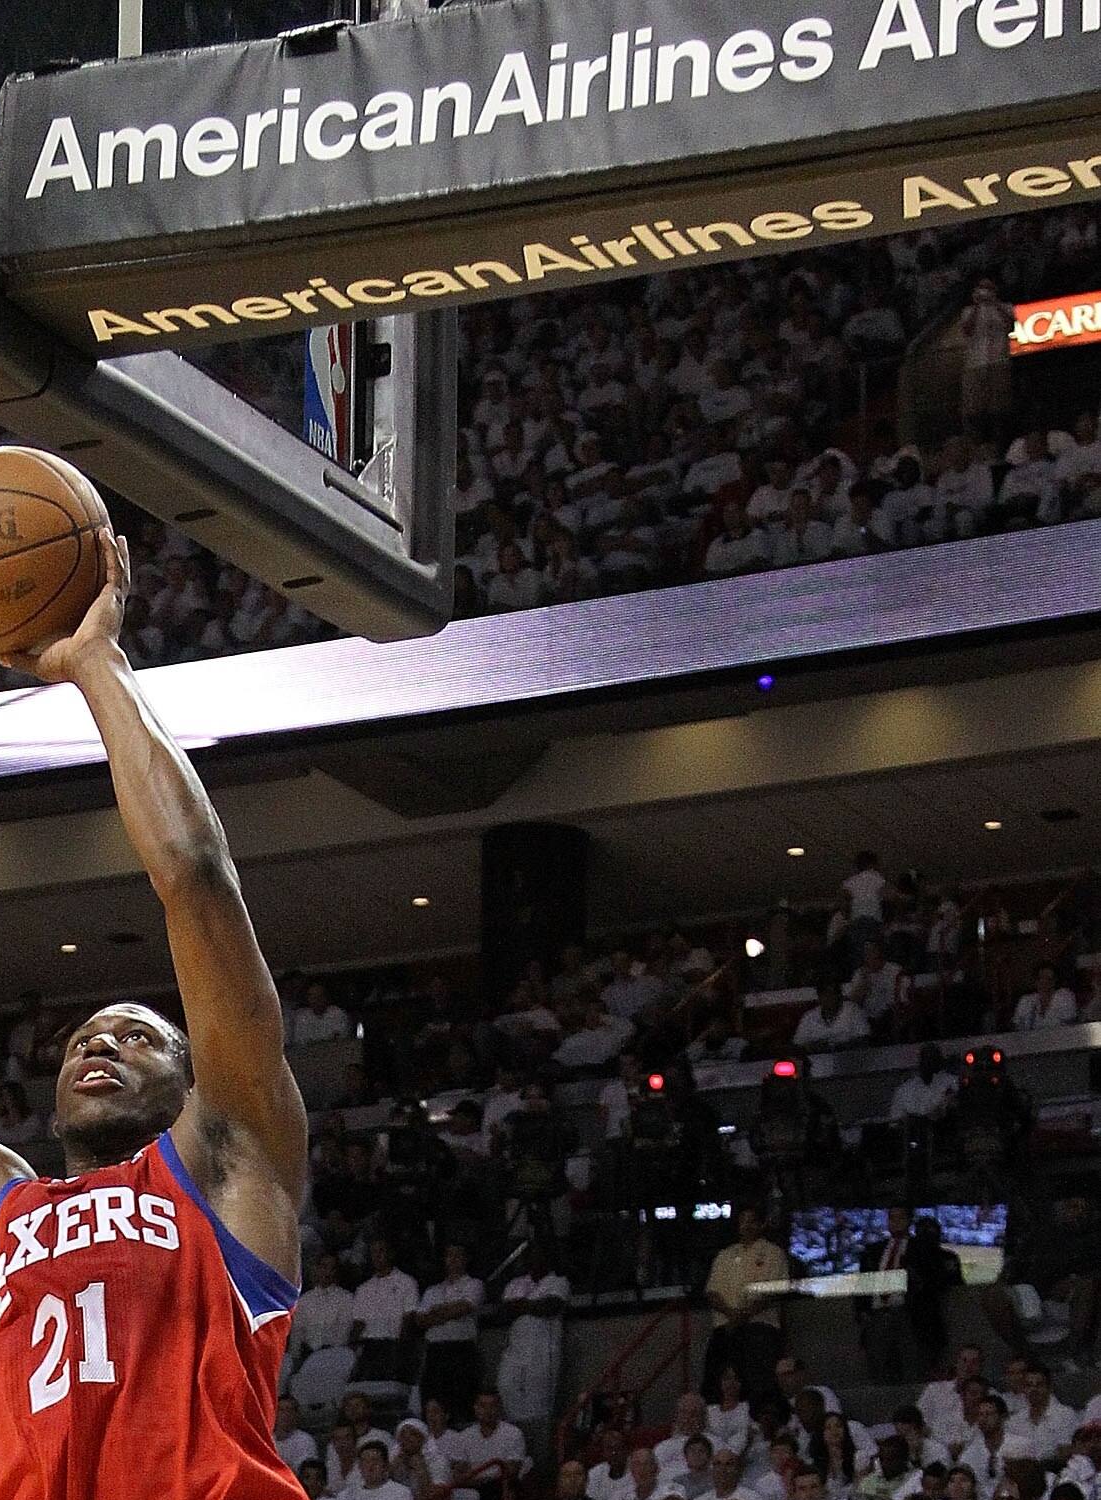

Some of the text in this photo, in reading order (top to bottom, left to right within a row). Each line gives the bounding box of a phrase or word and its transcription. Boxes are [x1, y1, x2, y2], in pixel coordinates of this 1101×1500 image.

[25, 18, 834, 201] AmericanAirlines
[87, 200, 874, 342] AmericanAirlines
[308, 417, 334, 458] NBA
[28, 1282, 116, 1415] 21
